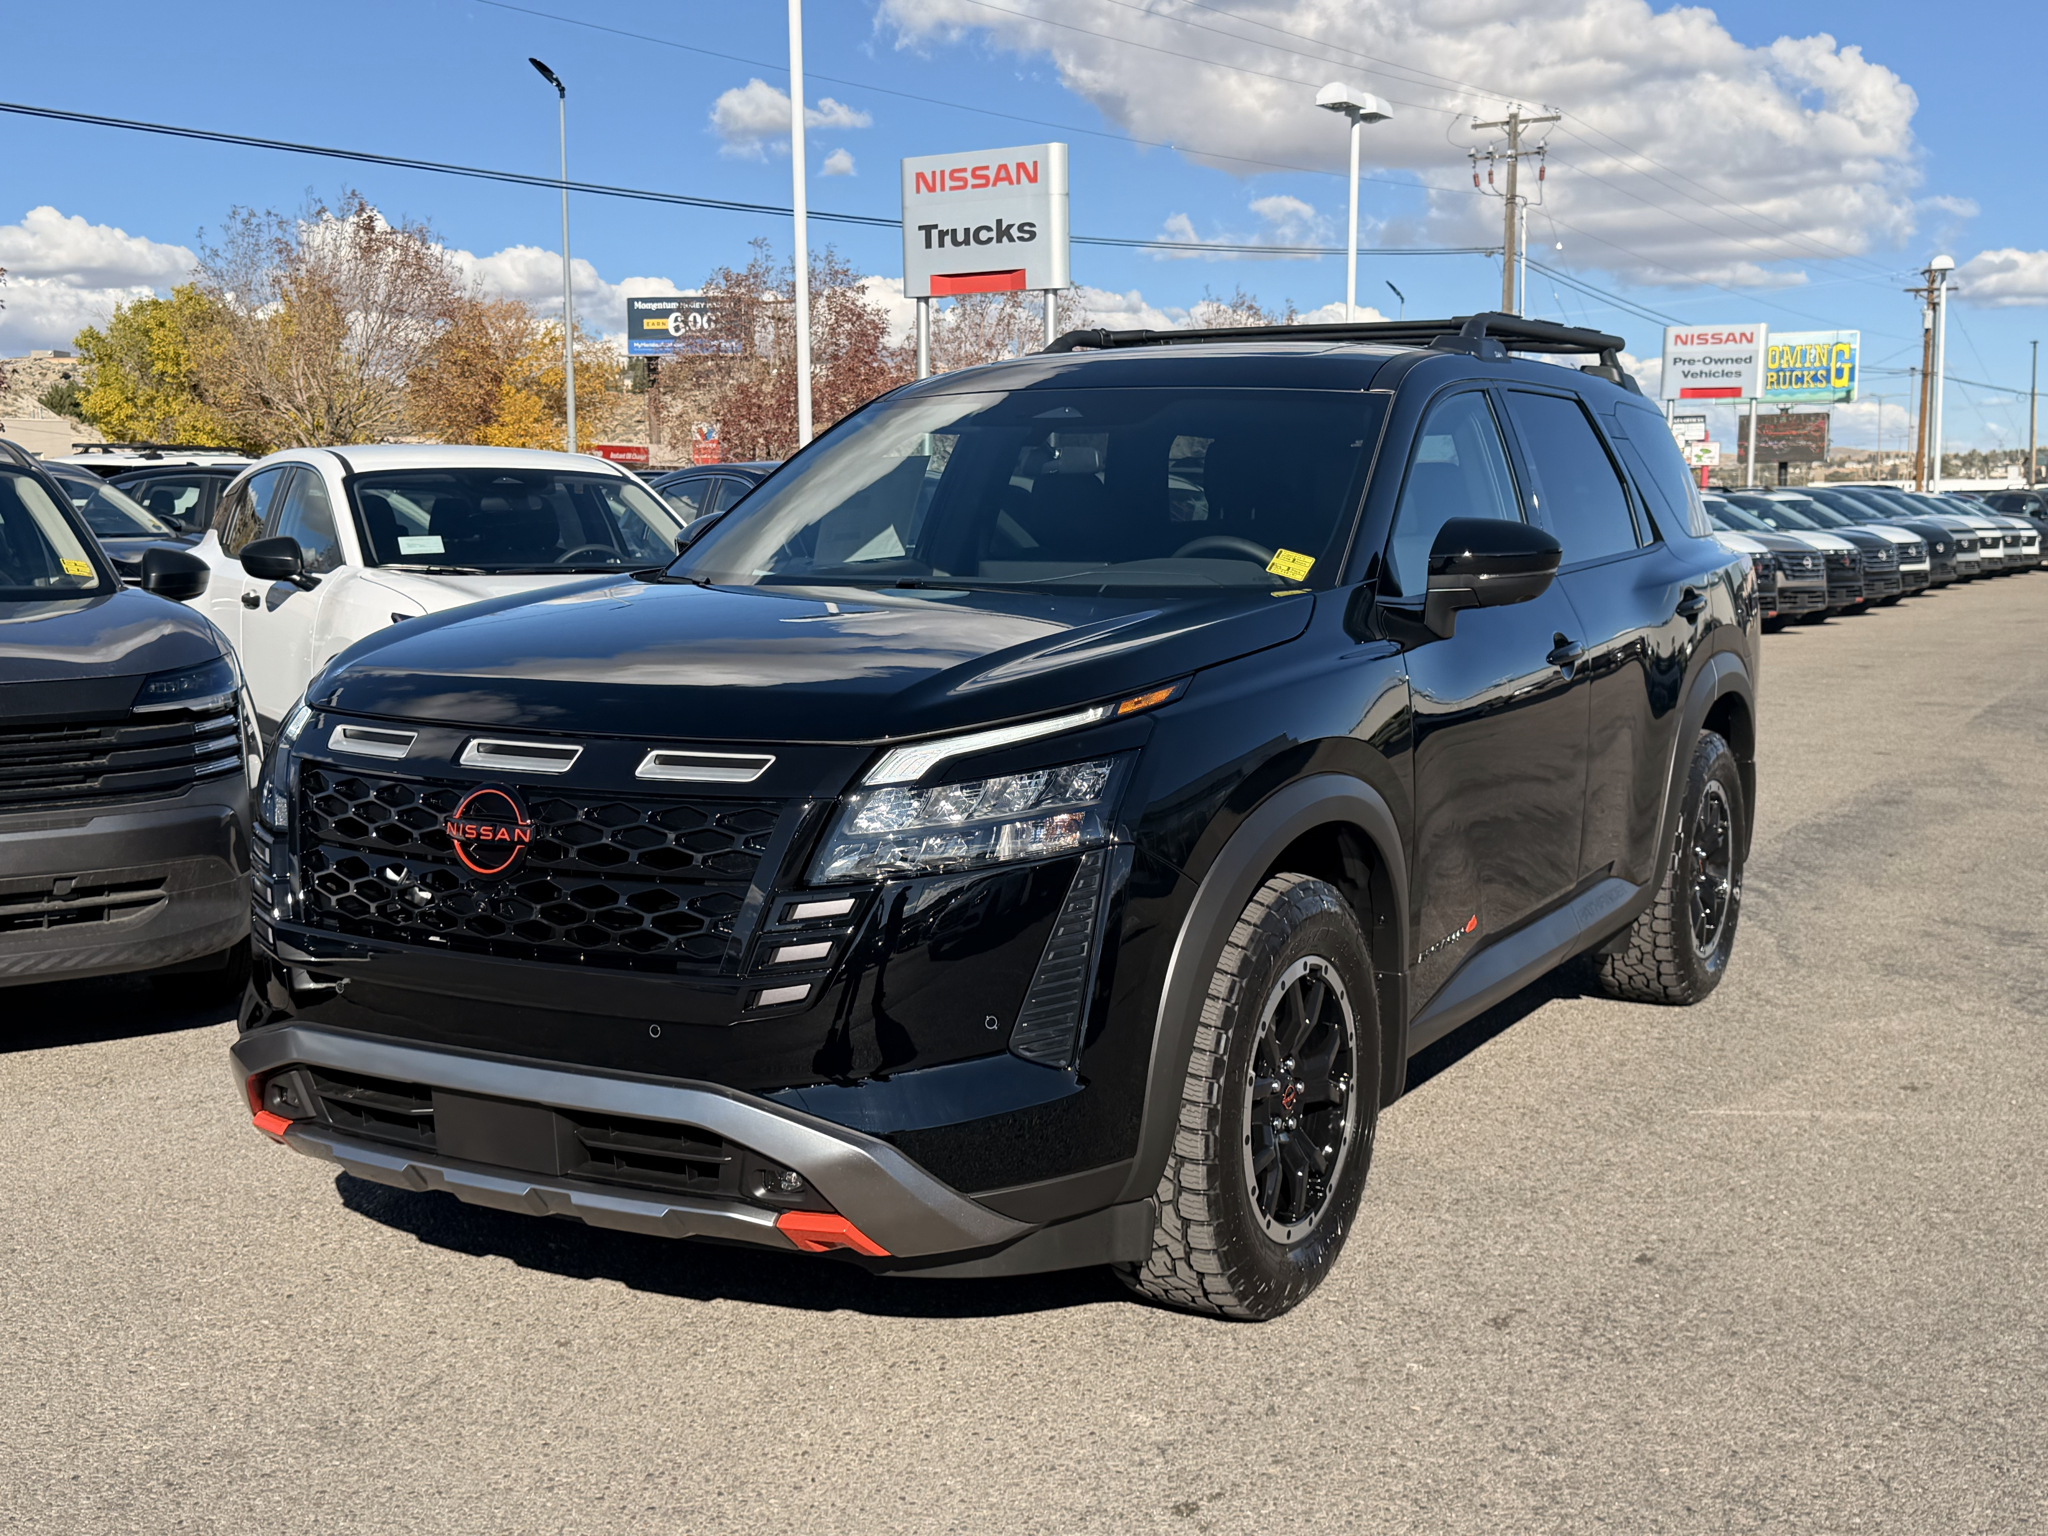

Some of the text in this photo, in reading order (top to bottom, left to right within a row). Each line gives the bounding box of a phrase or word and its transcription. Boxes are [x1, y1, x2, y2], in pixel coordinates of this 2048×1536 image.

[915, 160, 1039, 195] NISSAN
[917, 218, 1038, 250] Trucks
[634, 301, 679, 310] Momentum
[1674, 331, 1754, 346] NISSAN
[1673, 355, 1752, 366] Pre-Owned
[1681, 369, 1742, 379] Vehicles
[446, 821, 531, 843] NISSAN
